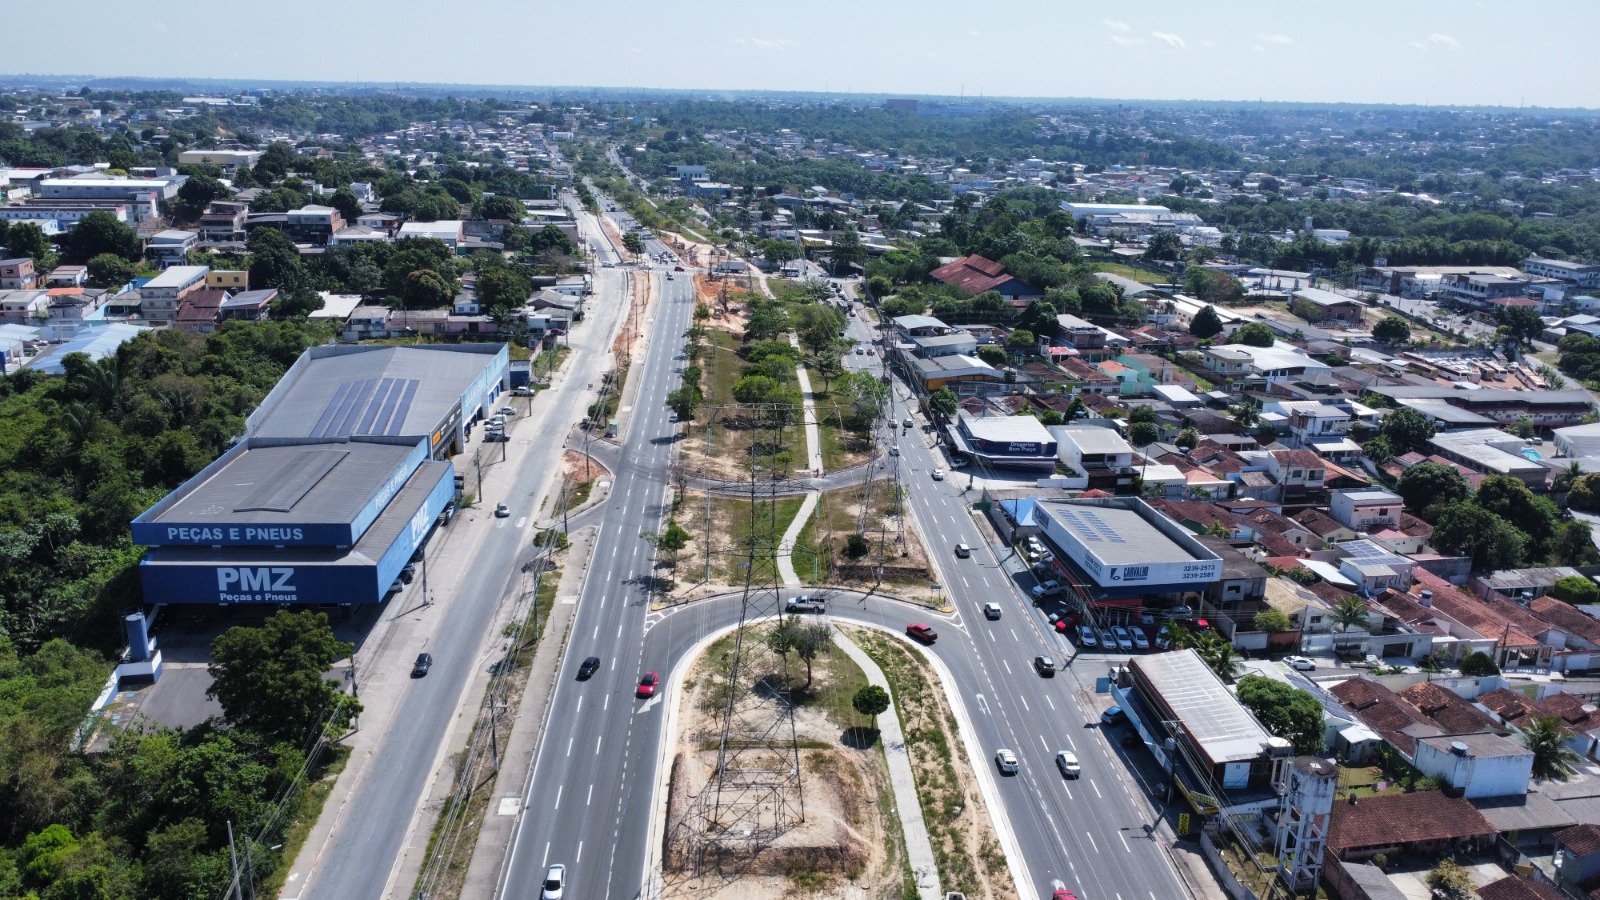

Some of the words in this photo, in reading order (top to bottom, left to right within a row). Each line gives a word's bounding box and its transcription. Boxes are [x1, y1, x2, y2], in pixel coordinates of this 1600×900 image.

[168, 527, 223, 542] PEÇAS
[230, 528, 240, 540] E
[246, 528, 303, 540] PNEUS
[1124, 566, 1149, 578] CARVALHO
[217, 568, 296, 591] PMZ
[220, 593, 252, 602] Peças
